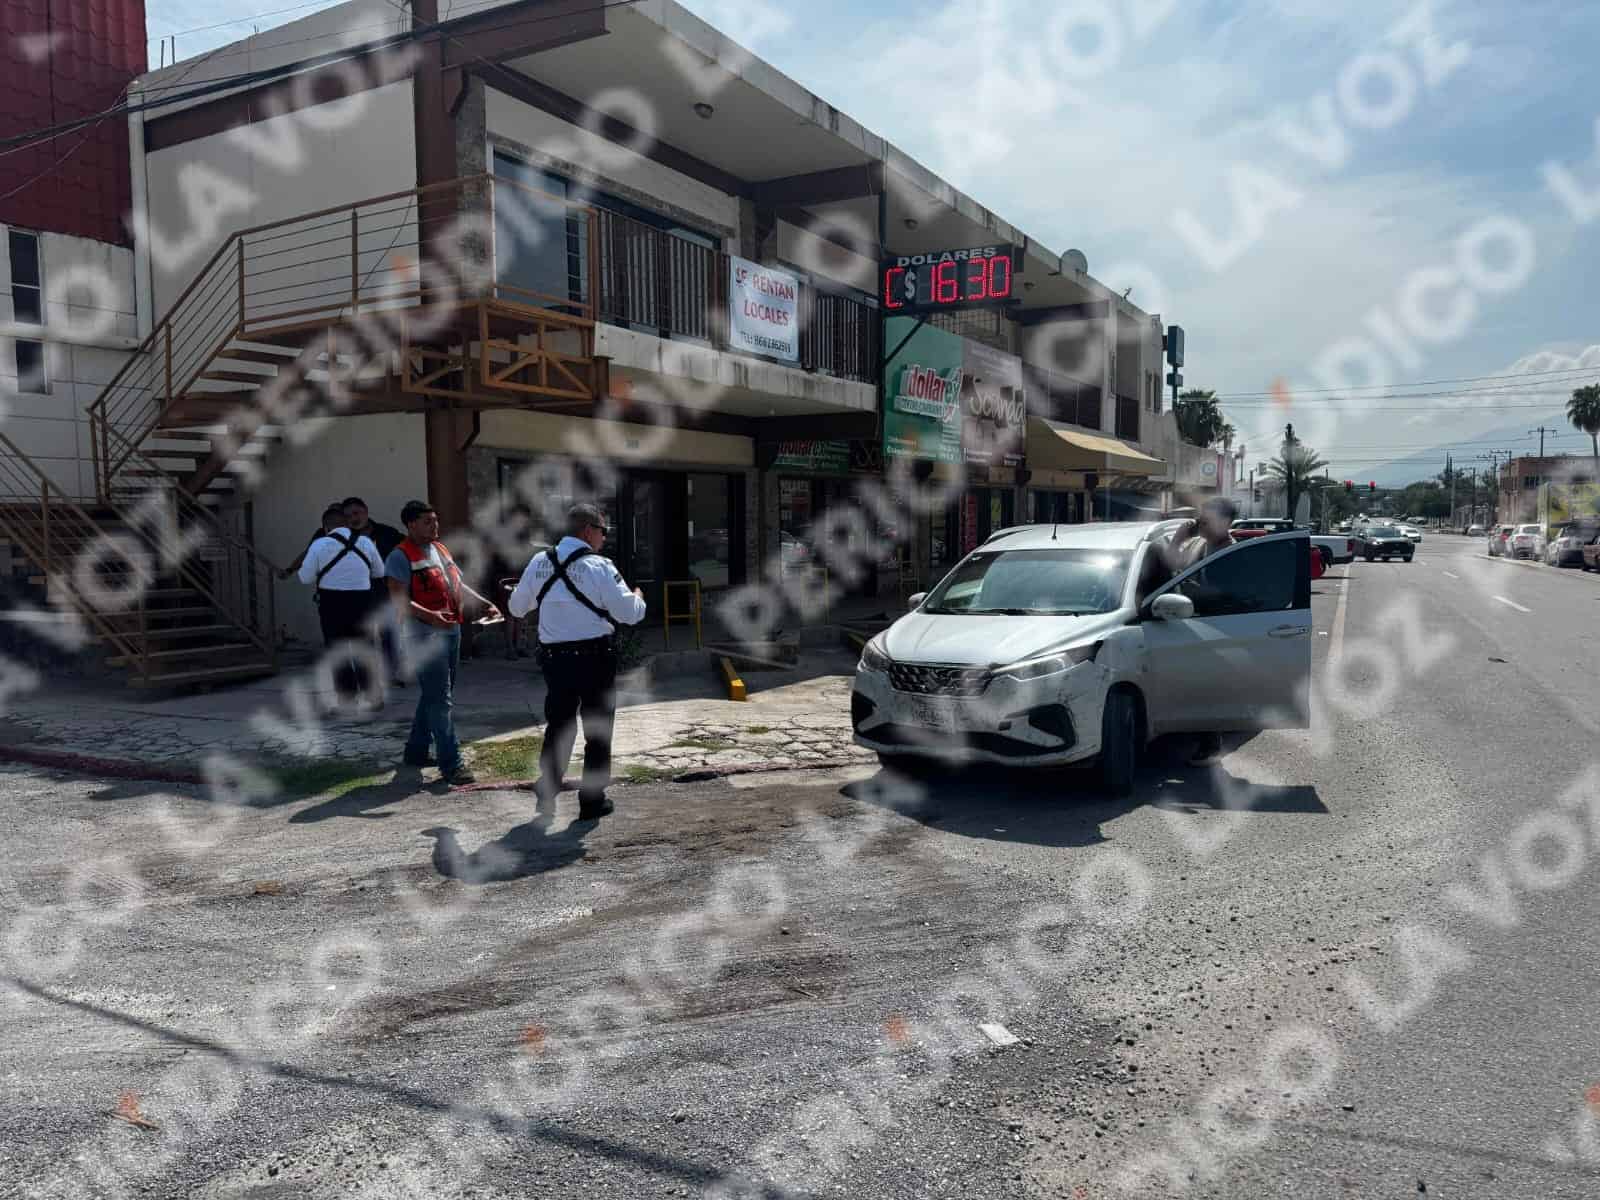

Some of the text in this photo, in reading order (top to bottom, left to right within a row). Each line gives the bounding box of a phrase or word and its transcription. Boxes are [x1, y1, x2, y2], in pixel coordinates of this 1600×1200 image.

[897, 246, 997, 267] DOLARES
[752, 273, 794, 301] RENTAN
[743, 299, 789, 326] LOCALES
